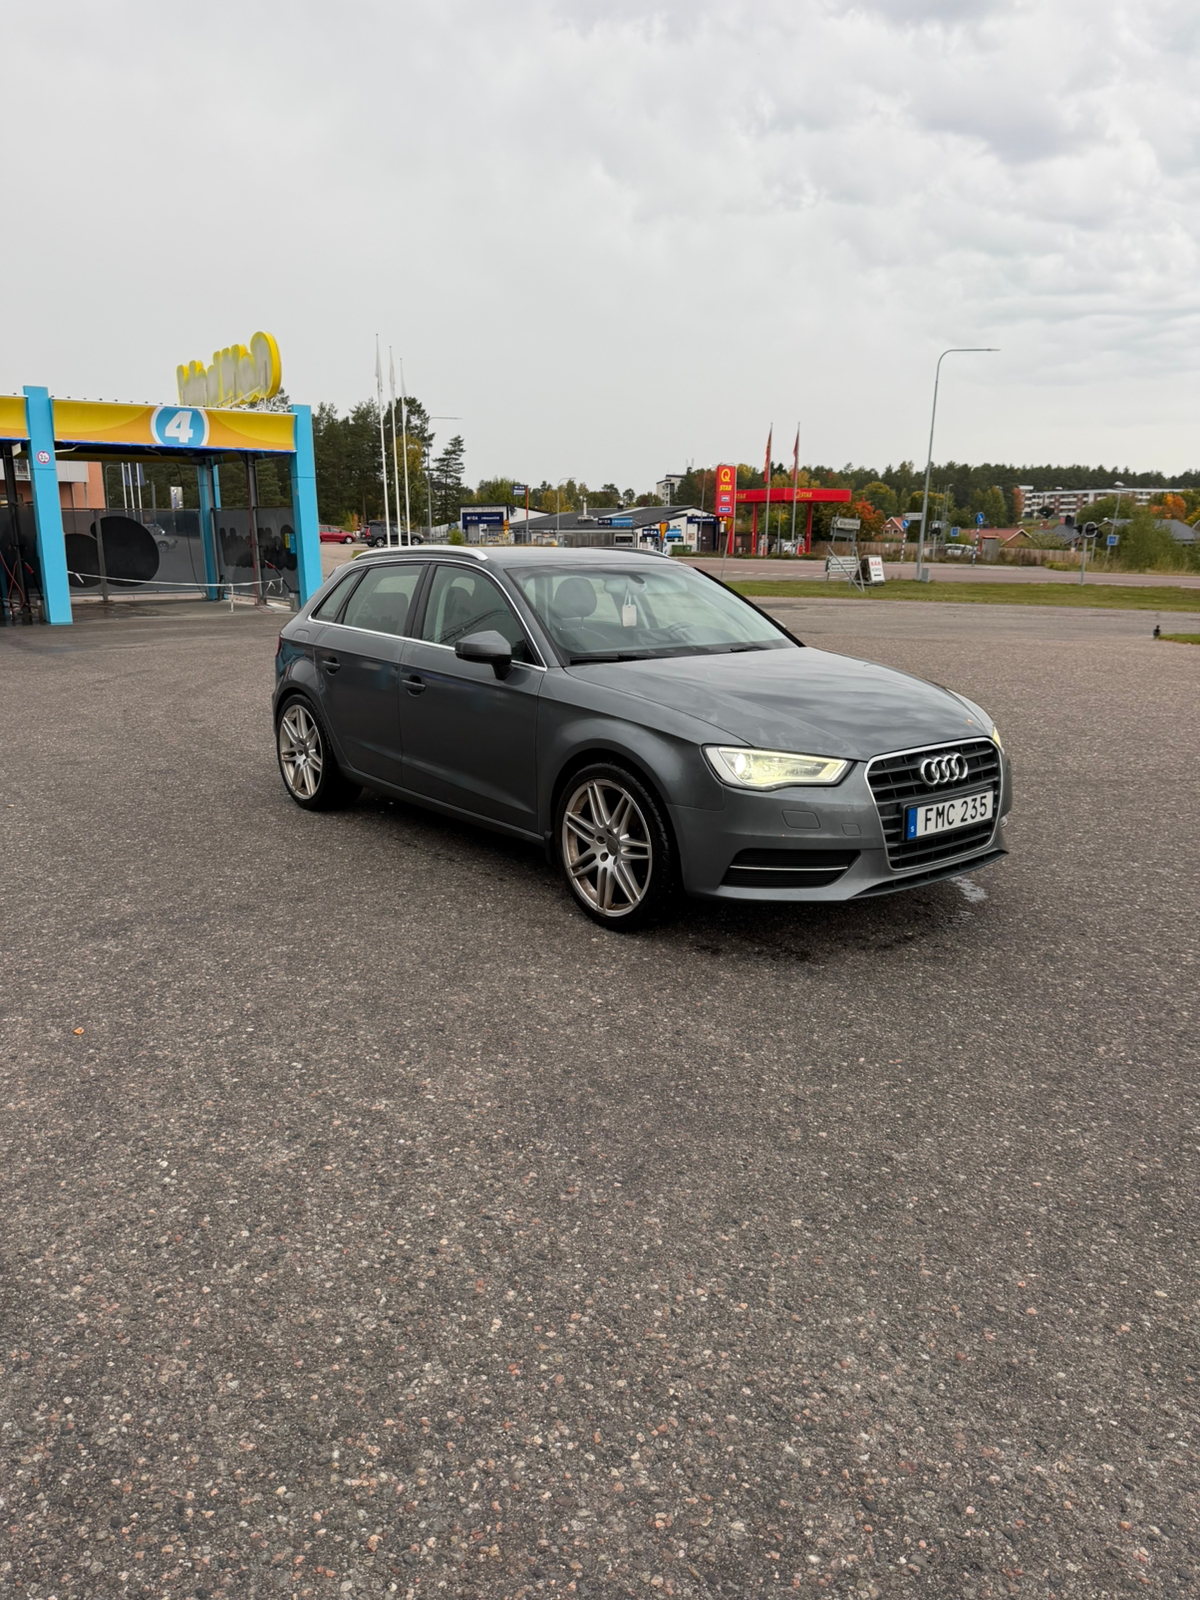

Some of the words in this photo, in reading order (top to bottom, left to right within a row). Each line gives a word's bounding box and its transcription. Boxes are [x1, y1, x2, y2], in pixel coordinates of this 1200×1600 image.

[164, 410, 194, 443] 4
[720, 468, 731, 483] Q
[924, 804, 956, 831] FMC
[960, 795, 987, 822] 235
